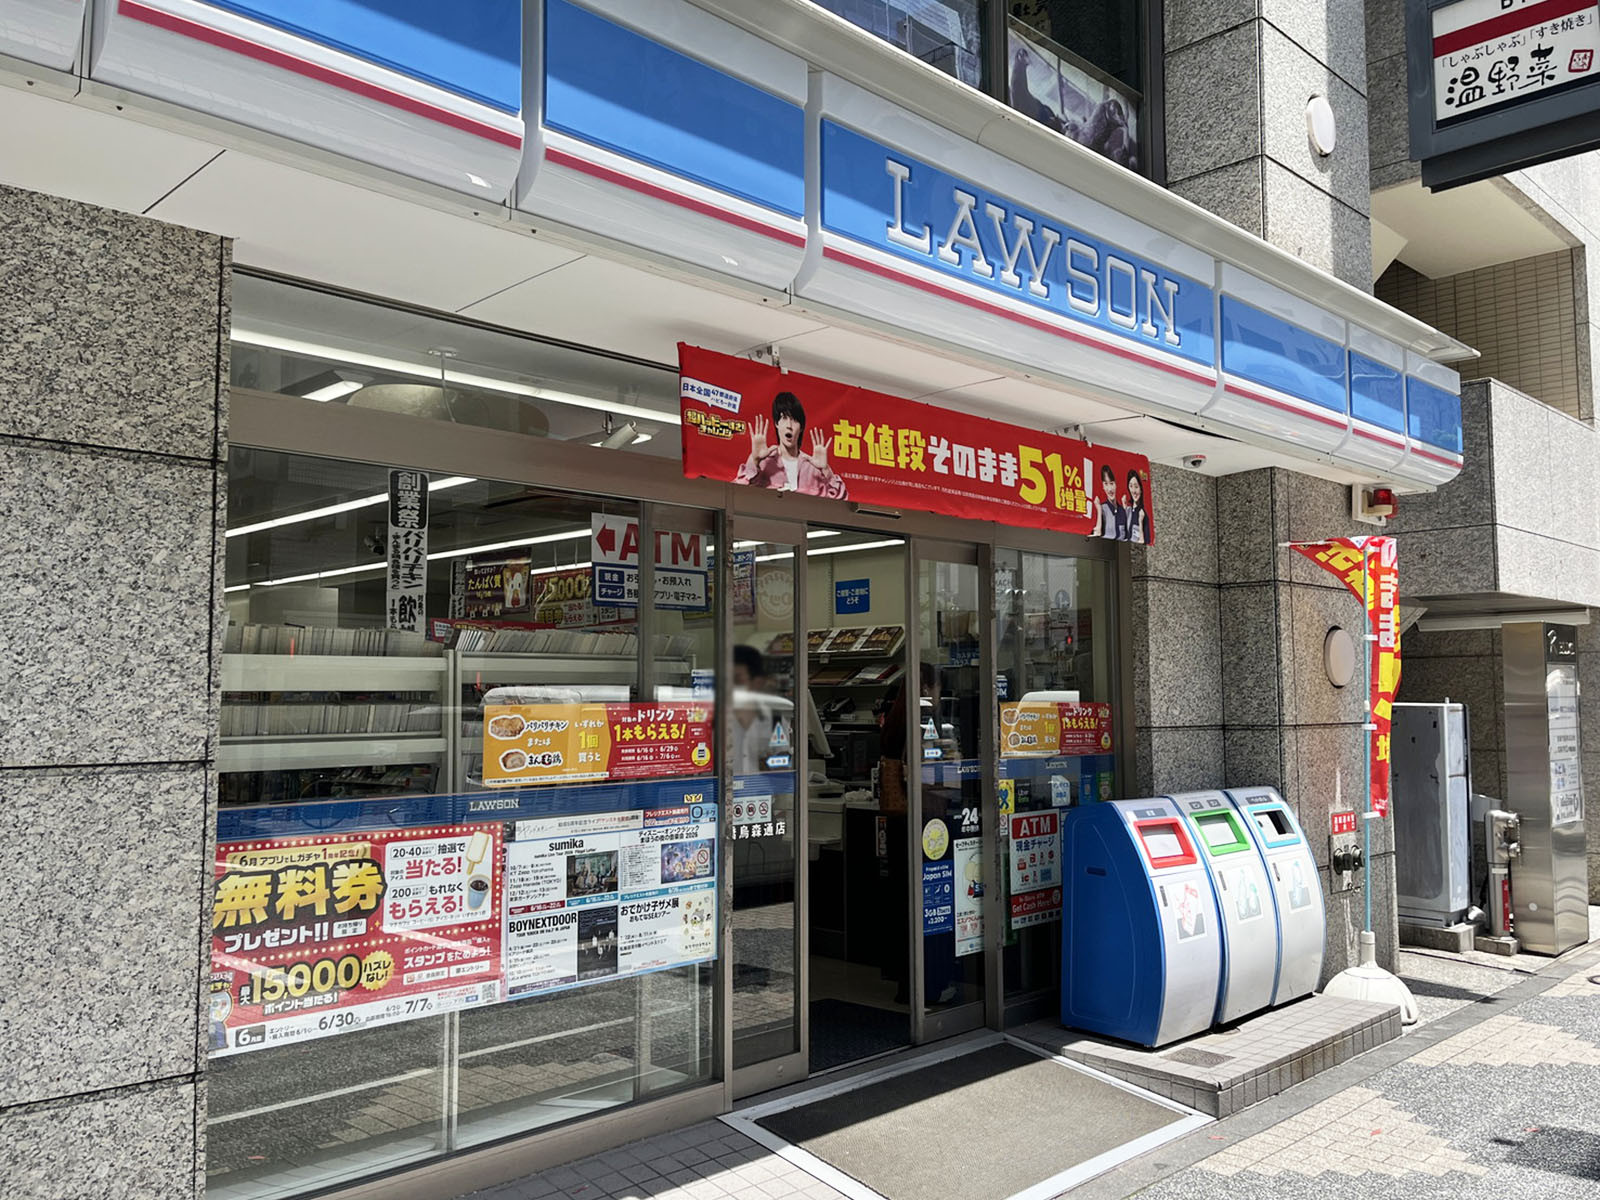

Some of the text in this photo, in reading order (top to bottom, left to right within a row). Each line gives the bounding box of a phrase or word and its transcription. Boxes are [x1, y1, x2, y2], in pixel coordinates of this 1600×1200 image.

[1445, 44, 1558, 108] 温野菜
[886, 156, 1181, 348] LAWSON
[397, 471, 421, 528] 創業祭
[619, 522, 700, 567] ATM
[401, 530, 425, 590] パリパリチキン
[614, 722, 686, 742] 1本もらえる!
[469, 798, 519, 812] LAWSON
[962, 807, 978, 826] 24
[1020, 815, 1051, 837] ATM
[438, 842, 466, 855] 抽選で
[549, 838, 584, 852] sumika
[1016, 835, 1055, 853] 現金チャージ
[239, 855, 257, 867] 6月
[405, 856, 462, 880] 当たる!
[923, 872, 942, 881] Japan
[212, 862, 384, 930] 無料券
[391, 887, 412, 899] 200
[428, 882, 463, 896] もれなく
[389, 895, 463, 921] もらえる!
[620, 897, 680, 916] おでかけ子ザメ展
[1023, 901, 1036, 911] Cash
[509, 912, 577, 934] BOYNEXTDOOR
[223, 921, 329, 954] プレゼント!!
[363, 959, 392, 973] ハズレ
[365, 970, 389, 982] なし!
[251, 954, 361, 1004] 15,000
[263, 992, 339, 1016] ポイント当たる!
[404, 997, 429, 1014] 7/7
[319, 1011, 354, 1031] 6/30
